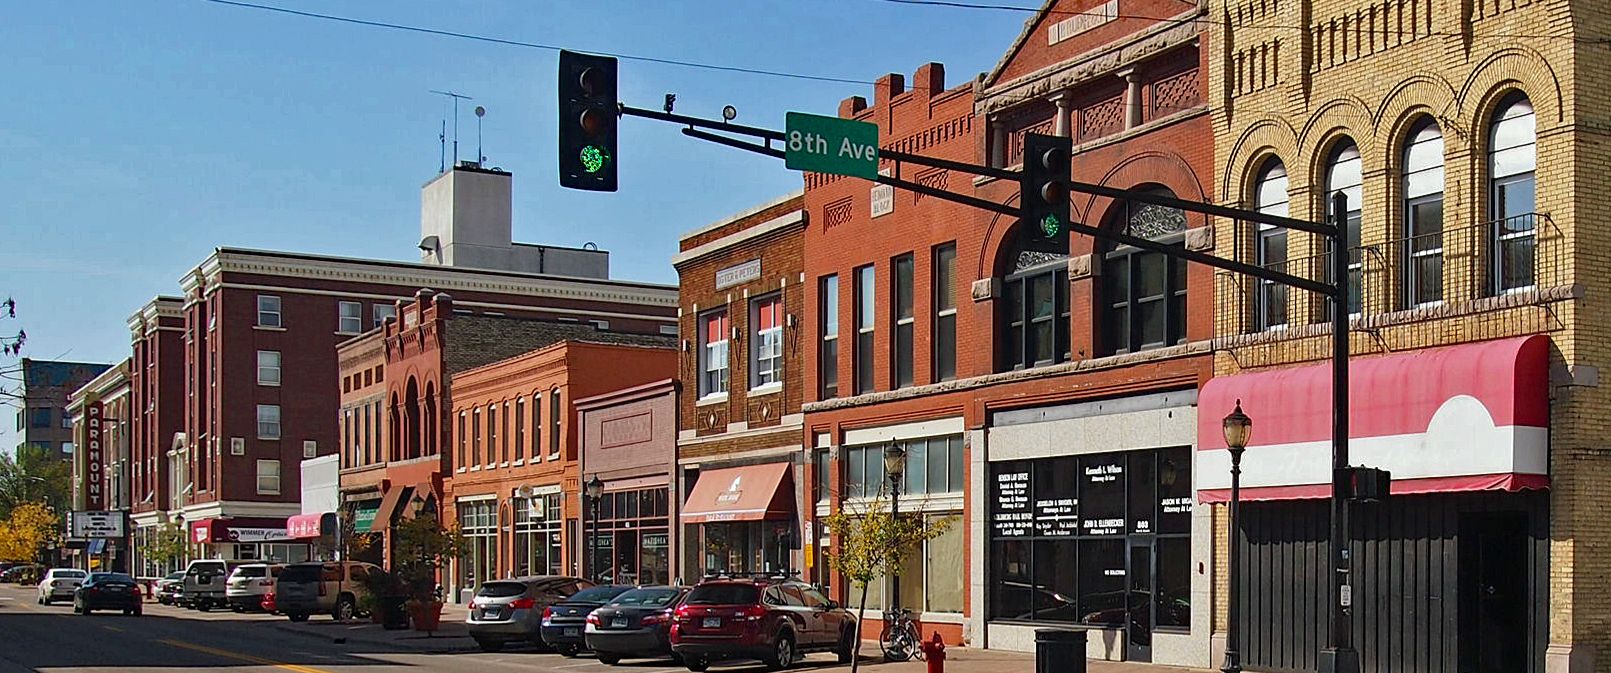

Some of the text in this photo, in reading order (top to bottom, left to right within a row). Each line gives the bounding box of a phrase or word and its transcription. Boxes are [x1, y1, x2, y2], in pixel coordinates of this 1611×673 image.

[789, 130, 876, 161] 8th Ave
[89, 407, 99, 505] PARAMOUNT
